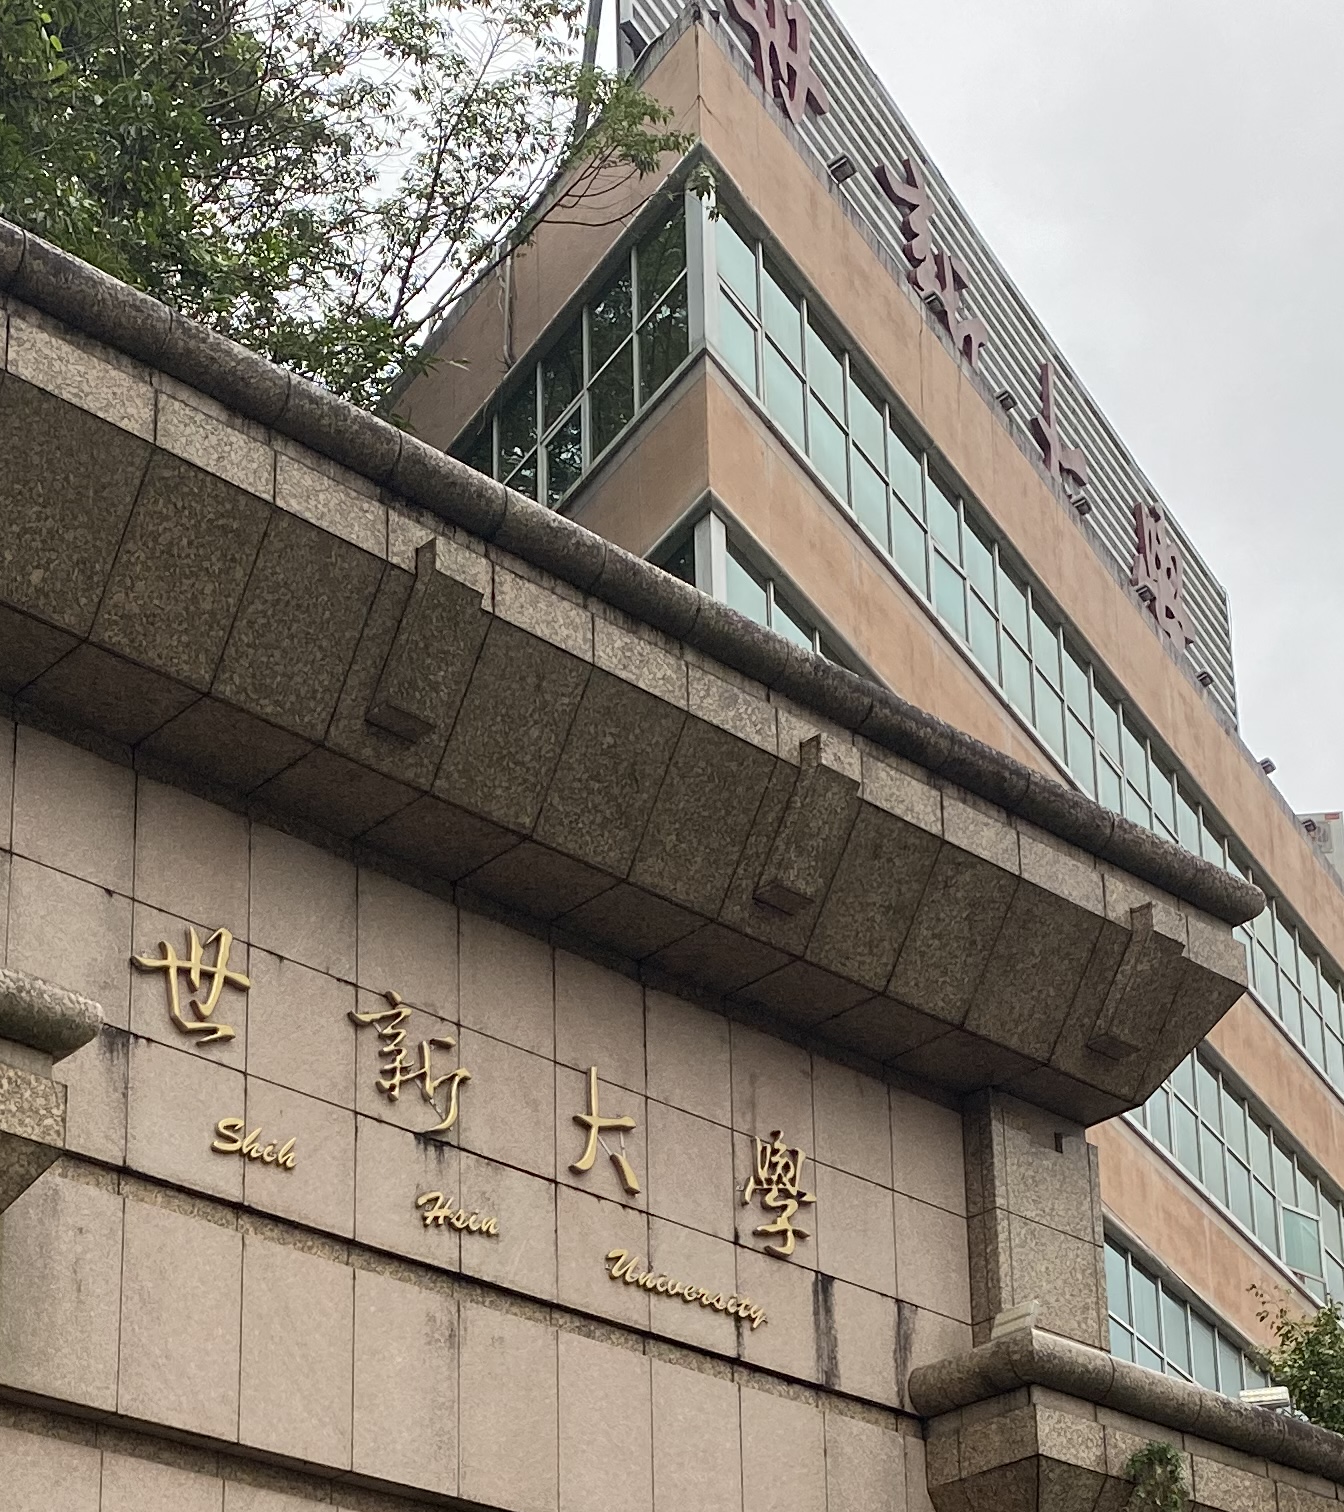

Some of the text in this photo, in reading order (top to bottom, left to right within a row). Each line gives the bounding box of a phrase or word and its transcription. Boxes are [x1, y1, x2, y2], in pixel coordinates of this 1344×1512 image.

[130, 925, 818, 1257] 世新大學
[211, 1116, 768, 1330] Shih Hsin University
